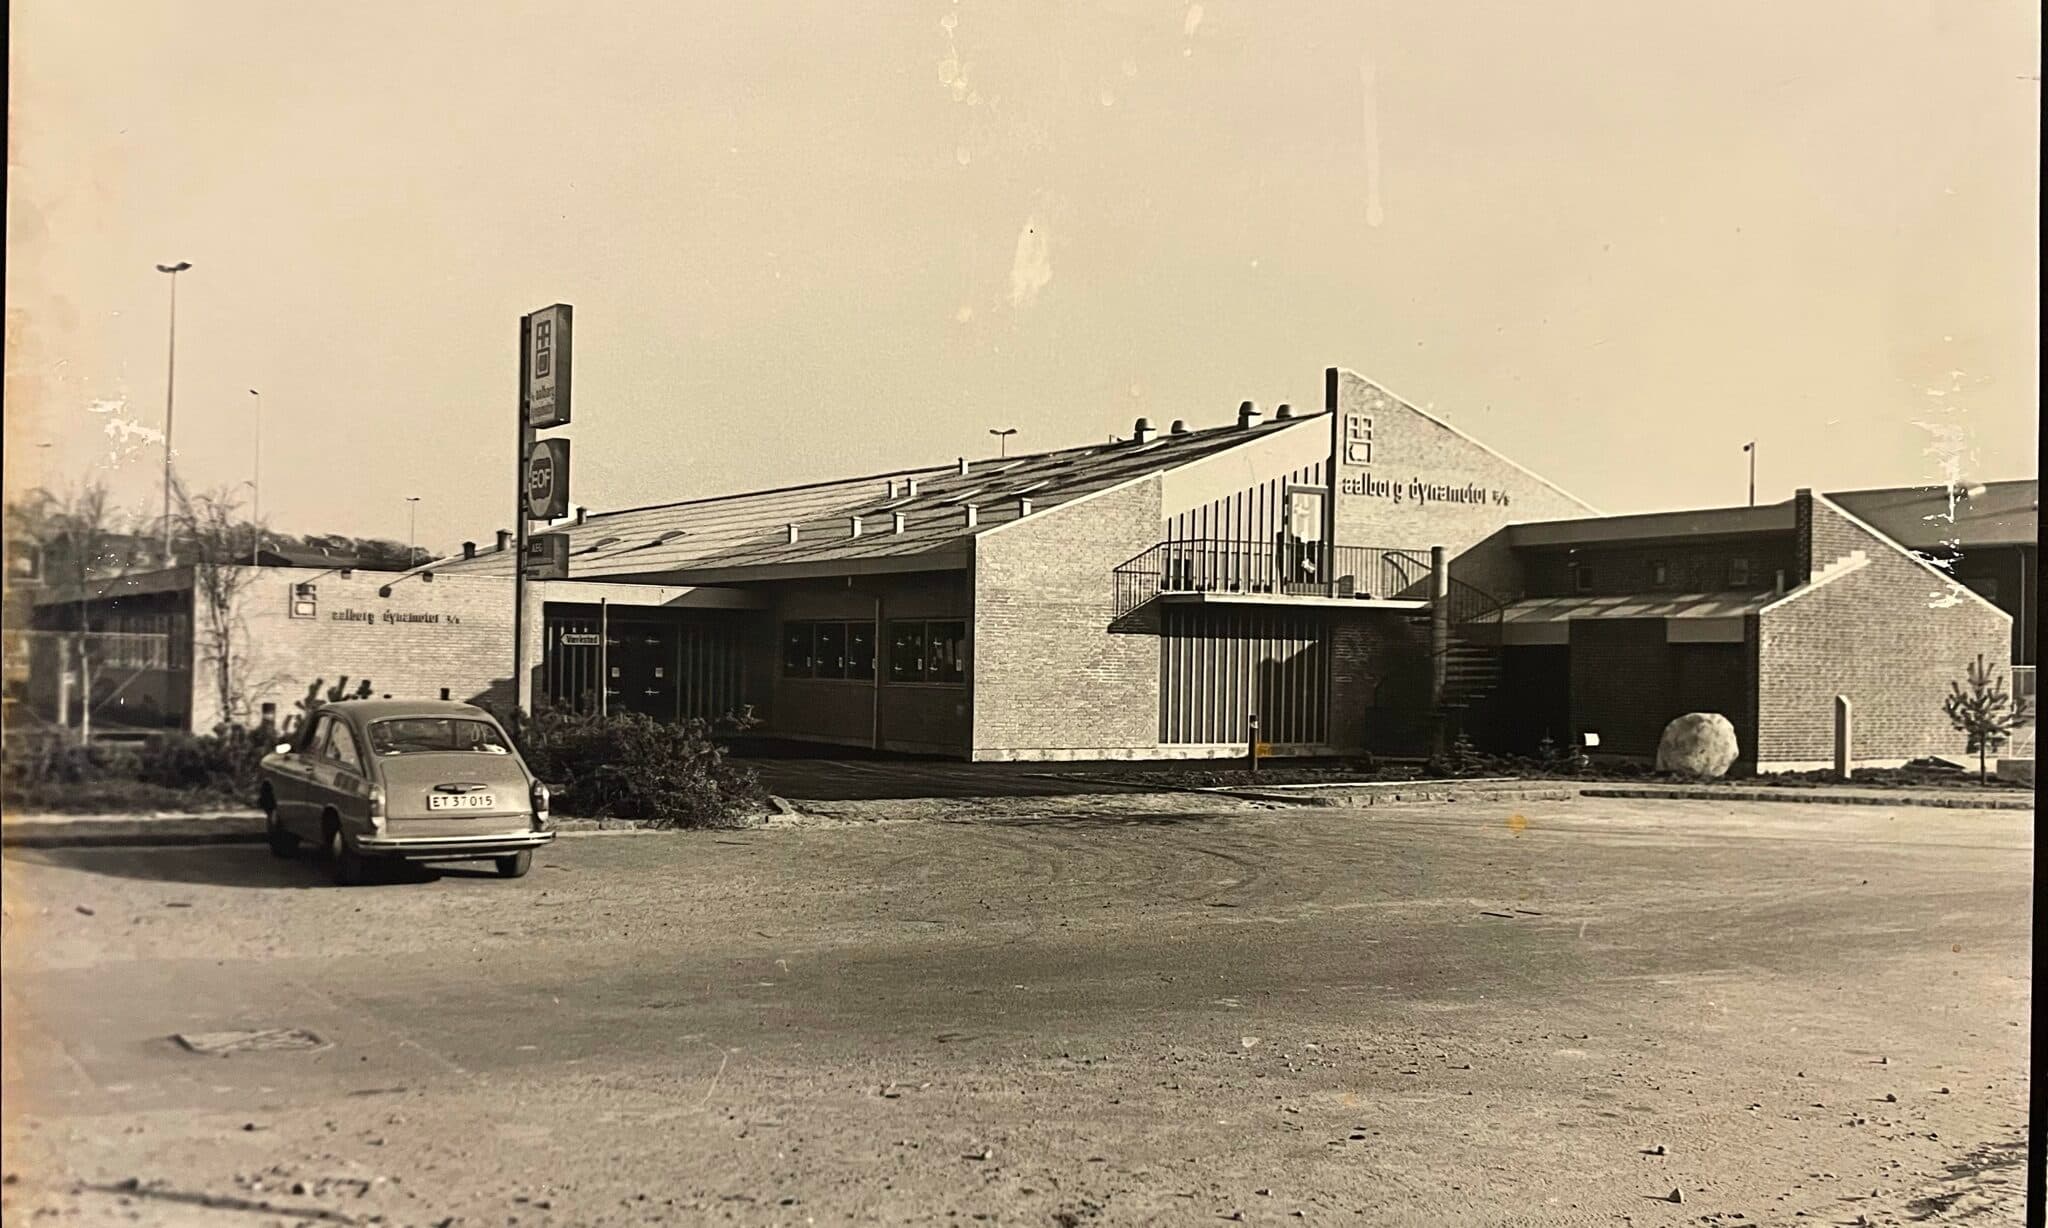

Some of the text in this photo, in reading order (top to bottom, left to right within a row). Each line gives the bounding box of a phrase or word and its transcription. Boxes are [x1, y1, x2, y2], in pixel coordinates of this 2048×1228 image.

[1342, 472, 1402, 504] aalborg
[1409, 477, 1486, 505] dynamotor
[332, 609, 374, 625] aalborg
